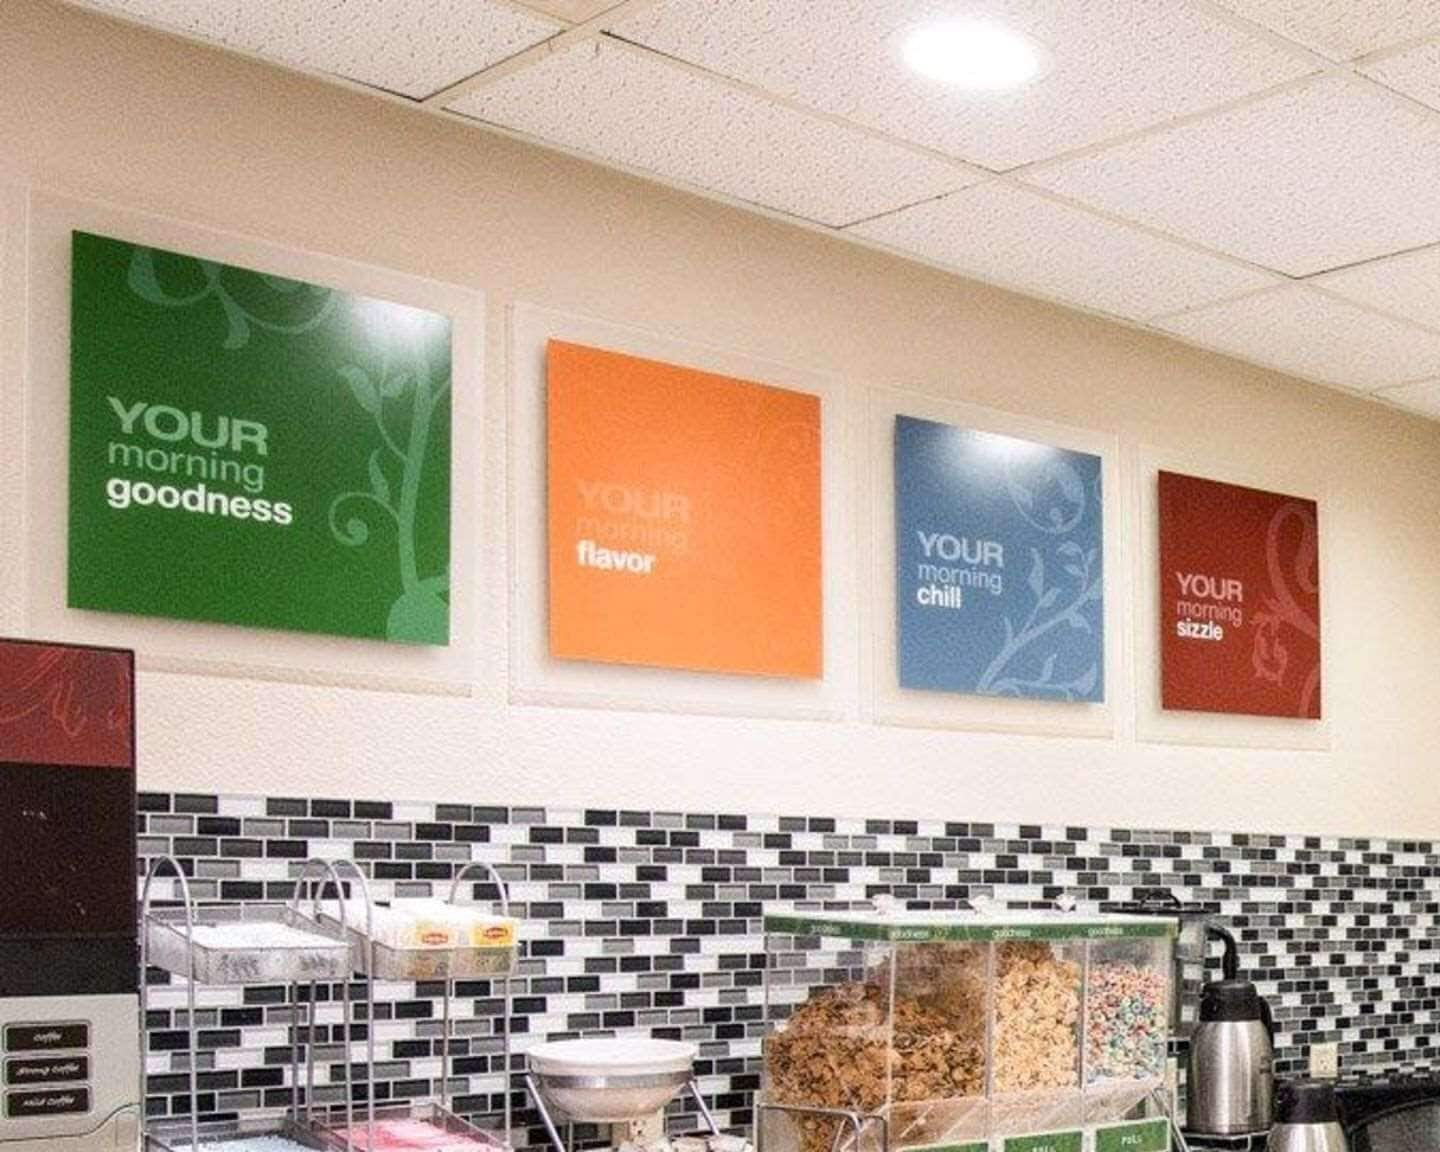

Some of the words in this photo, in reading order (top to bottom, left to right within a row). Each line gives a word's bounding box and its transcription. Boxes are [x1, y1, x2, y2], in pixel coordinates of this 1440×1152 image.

[106, 395, 268, 456] YOUR
[108, 441, 264, 494] morning
[106, 477, 293, 525] goodness
[577, 480, 688, 521] YOUR
[577, 538, 656, 574] flavor
[917, 530, 1004, 569] YOUR
[917, 584, 961, 609] chill
[918, 564, 1002, 595] morning
[1176, 571, 1243, 603] YOUR
[1176, 617, 1224, 641] sizzle
[1177, 600, 1242, 628] morning
